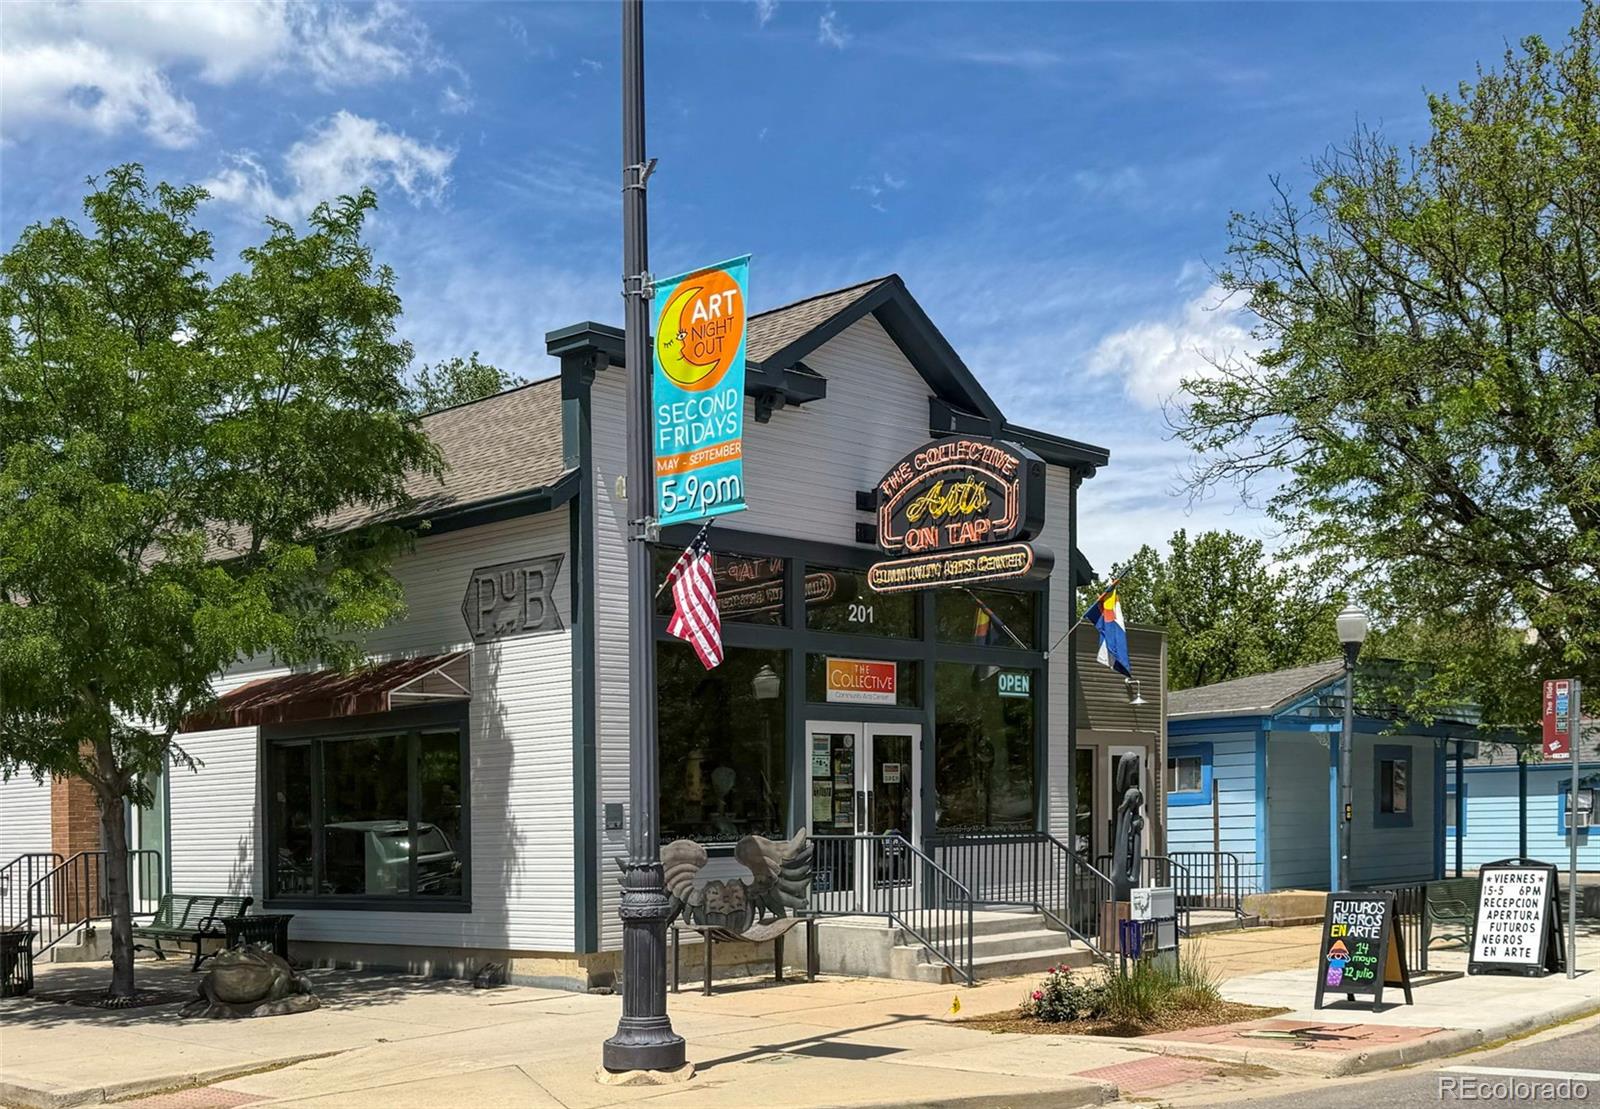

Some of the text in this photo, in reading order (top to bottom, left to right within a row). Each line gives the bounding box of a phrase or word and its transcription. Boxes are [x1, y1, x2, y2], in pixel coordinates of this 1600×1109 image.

[691, 289, 737, 325] ART
[691, 316, 735, 342] NIGHT
[694, 336, 725, 358] OUT
[658, 388, 738, 426] SECOND
[660, 412, 738, 450] FRIDAYS
[656, 457, 680, 472] MAY
[688, 442, 742, 466] SEPTEMBER
[880, 440, 1020, 497] THE COLLECTIVE
[661, 475, 742, 516] 5-9pm
[906, 474, 991, 522] Arts
[905, 518, 990, 551] ON TAP
[848, 604, 874, 624] 201
[855, 664, 871, 675] THE
[831, 669, 893, 690] COLLECTIVE
[998, 673, 1030, 693] OPEN
[1494, 873, 1536, 884] VIERNES
[1519, 885, 1541, 896] 6PM
[1333, 901, 1386, 915] FUTUROS
[1483, 897, 1538, 908] RECEPCION
[1332, 912, 1382, 927] NEGROS
[1486, 910, 1540, 920] APERTURA
[1330, 924, 1380, 939] EN ARTE
[1489, 922, 1536, 933] FUTUROS
[1481, 934, 1523, 945] NEGROS
[1355, 942, 1369, 955] 14
[1483, 946, 1532, 958] EN ARTE
[1344, 967, 1374, 981] 12 julio
